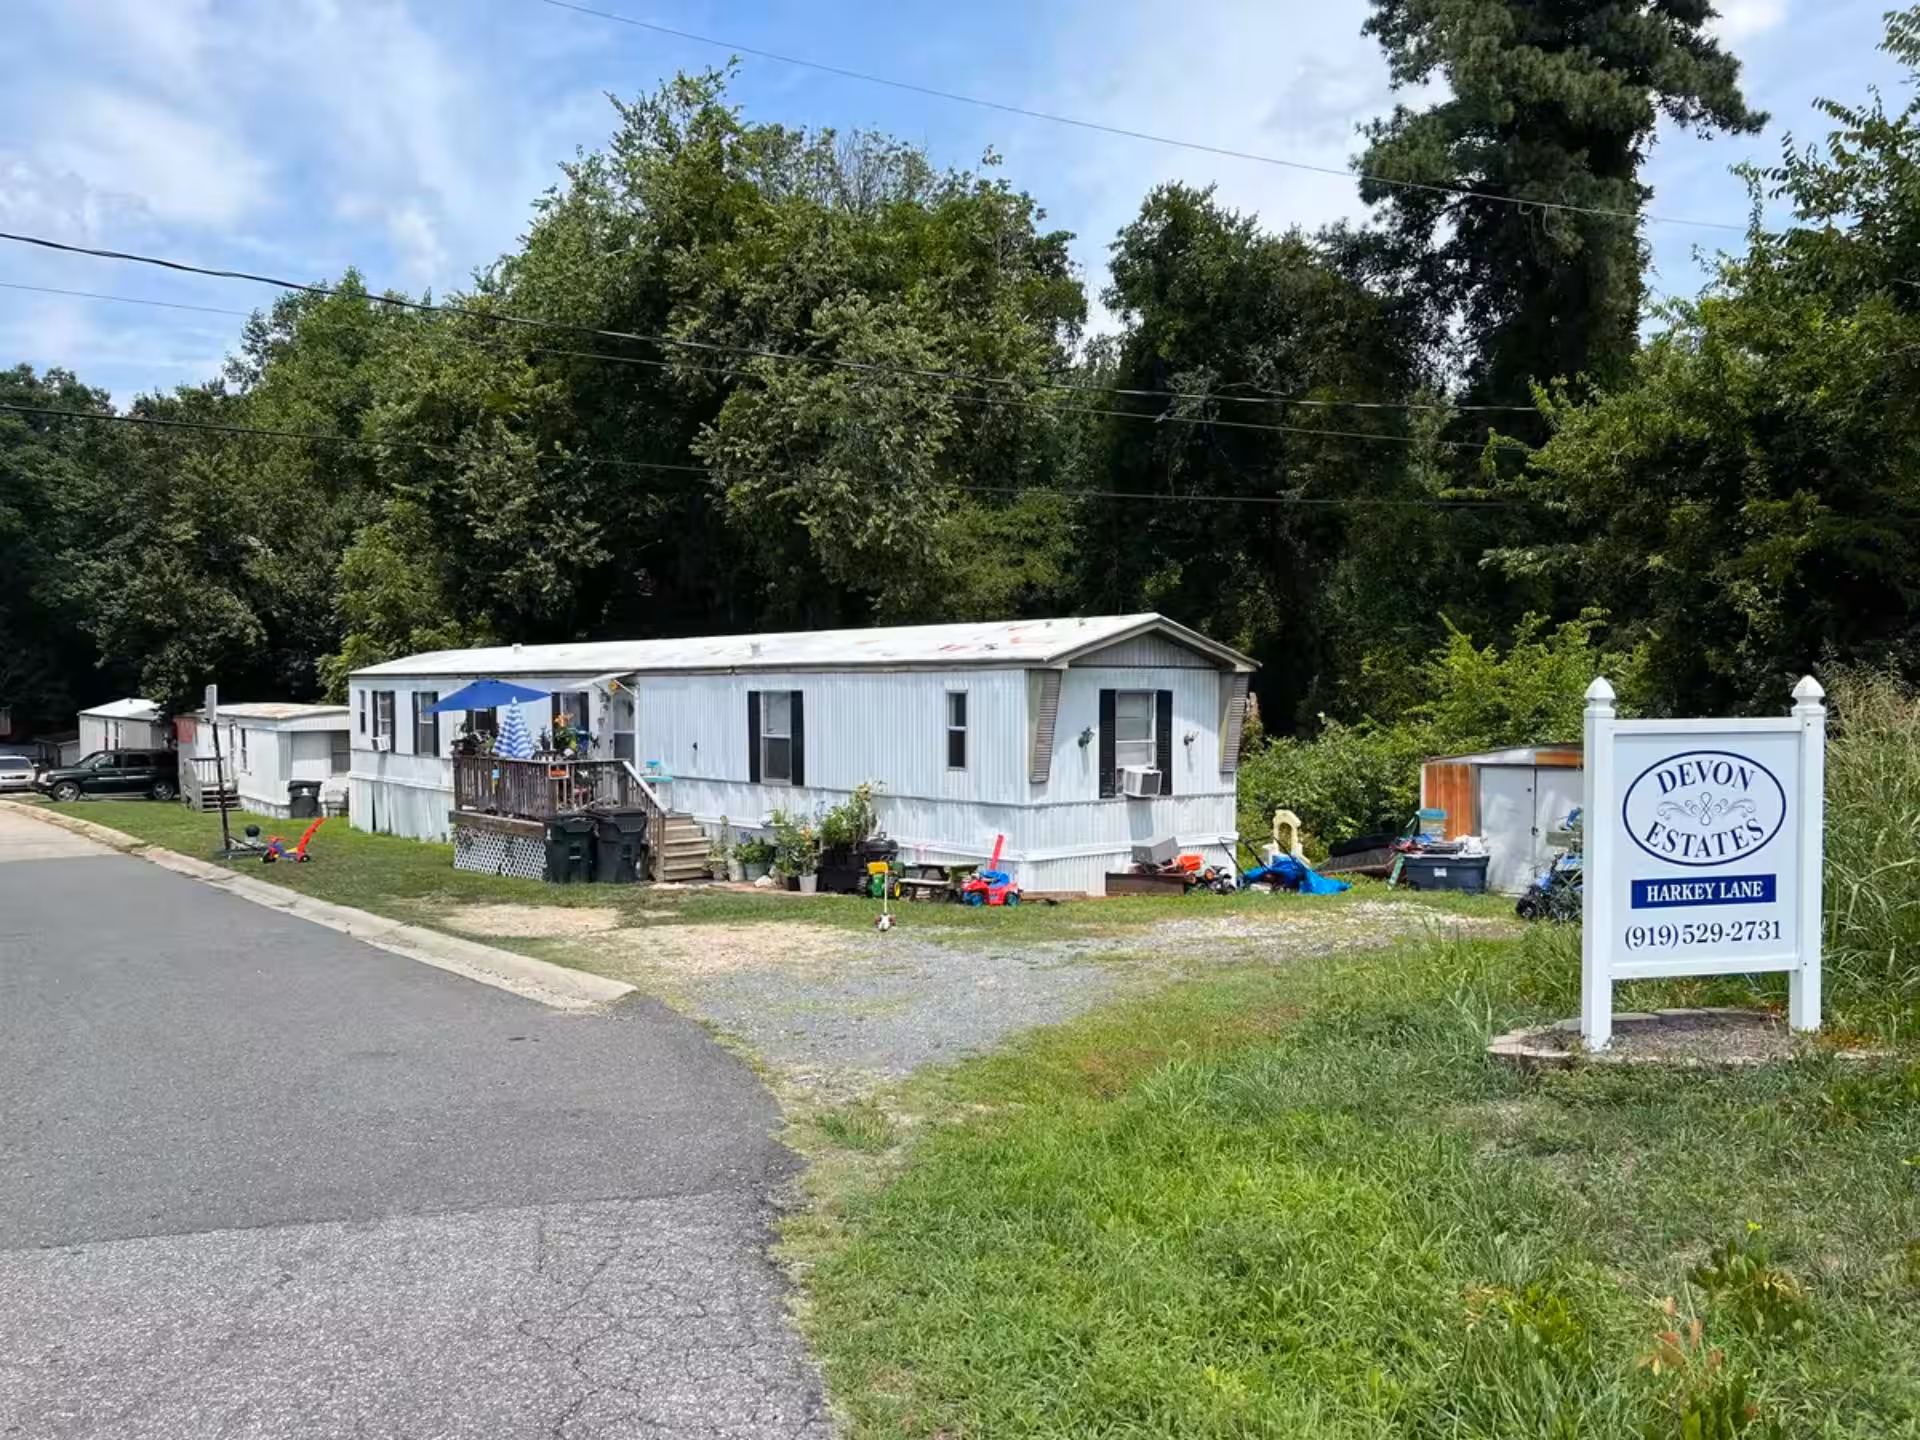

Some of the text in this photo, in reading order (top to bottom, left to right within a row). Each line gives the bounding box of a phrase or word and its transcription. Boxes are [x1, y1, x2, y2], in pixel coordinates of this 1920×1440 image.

[1655, 760, 1755, 794] DEVON
[1644, 818, 1764, 858] ESTATES
[1646, 880, 1763, 902] HARKEY LANE
